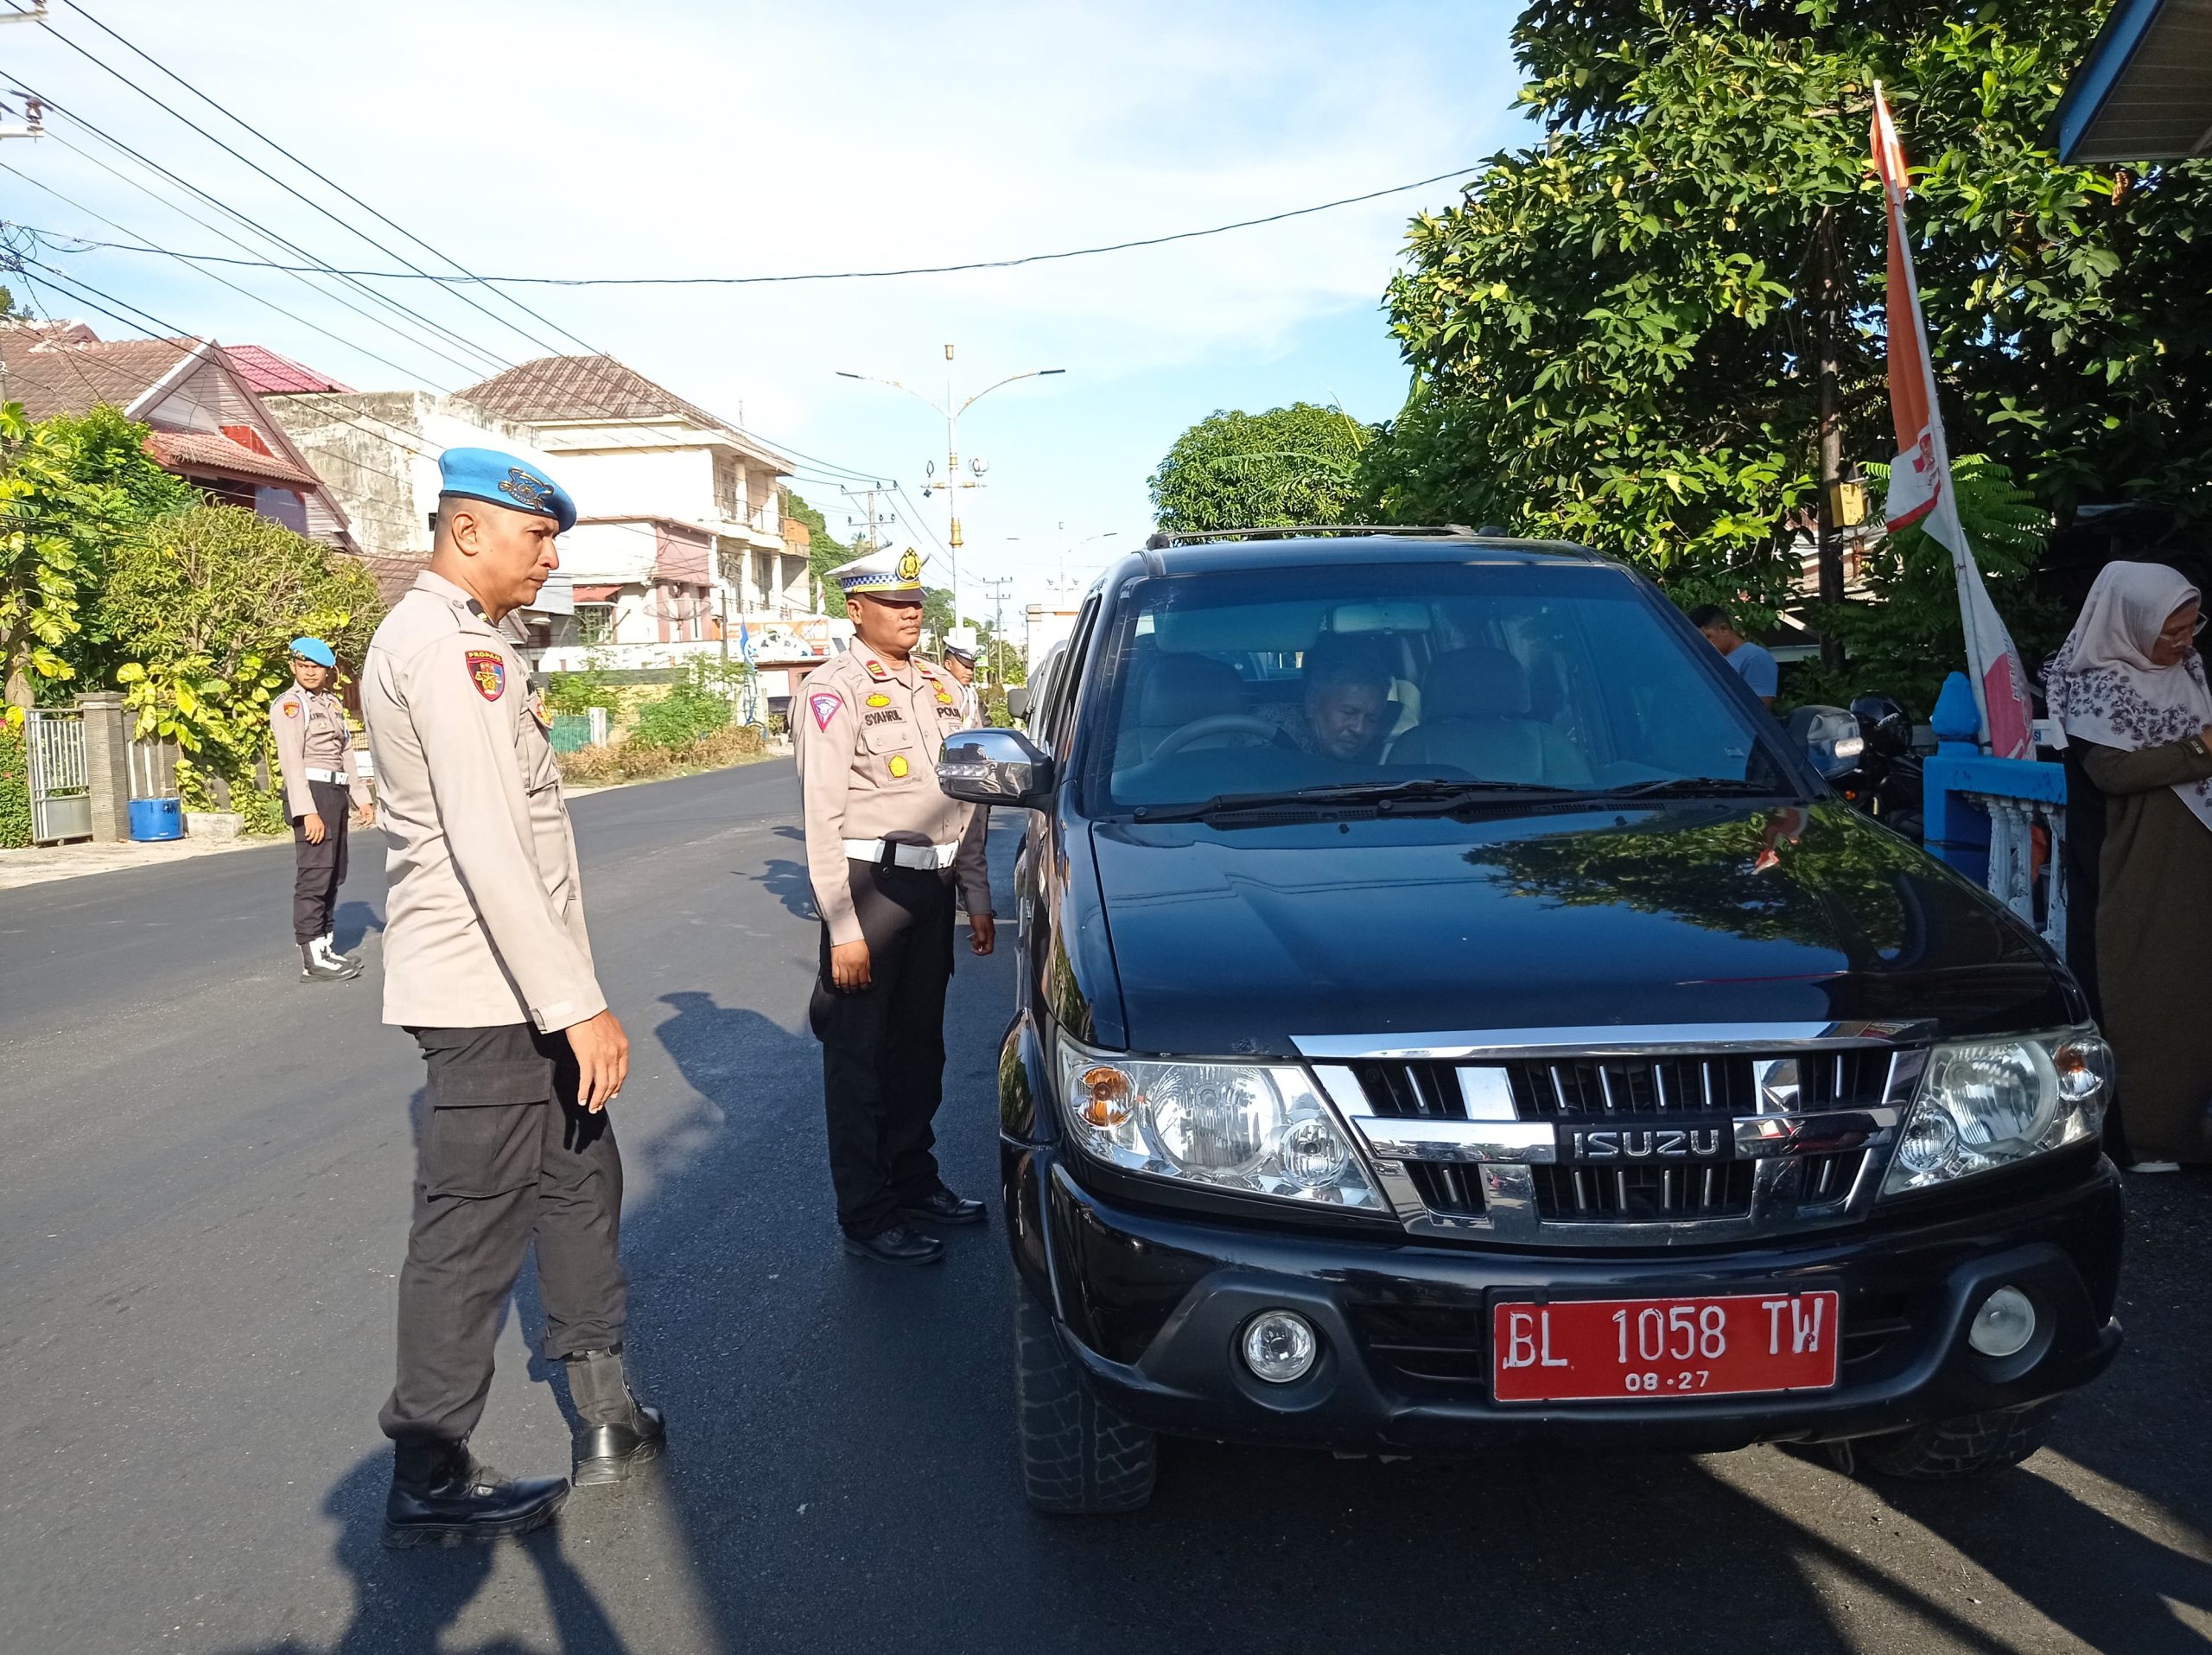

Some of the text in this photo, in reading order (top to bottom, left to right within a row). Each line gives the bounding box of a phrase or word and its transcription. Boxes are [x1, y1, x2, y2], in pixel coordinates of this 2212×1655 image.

[865, 710, 902, 726] SYAHRIL
[1573, 1129, 1719, 1159] ISUZU
[1503, 1297, 1824, 1370] BL 1058 TW
